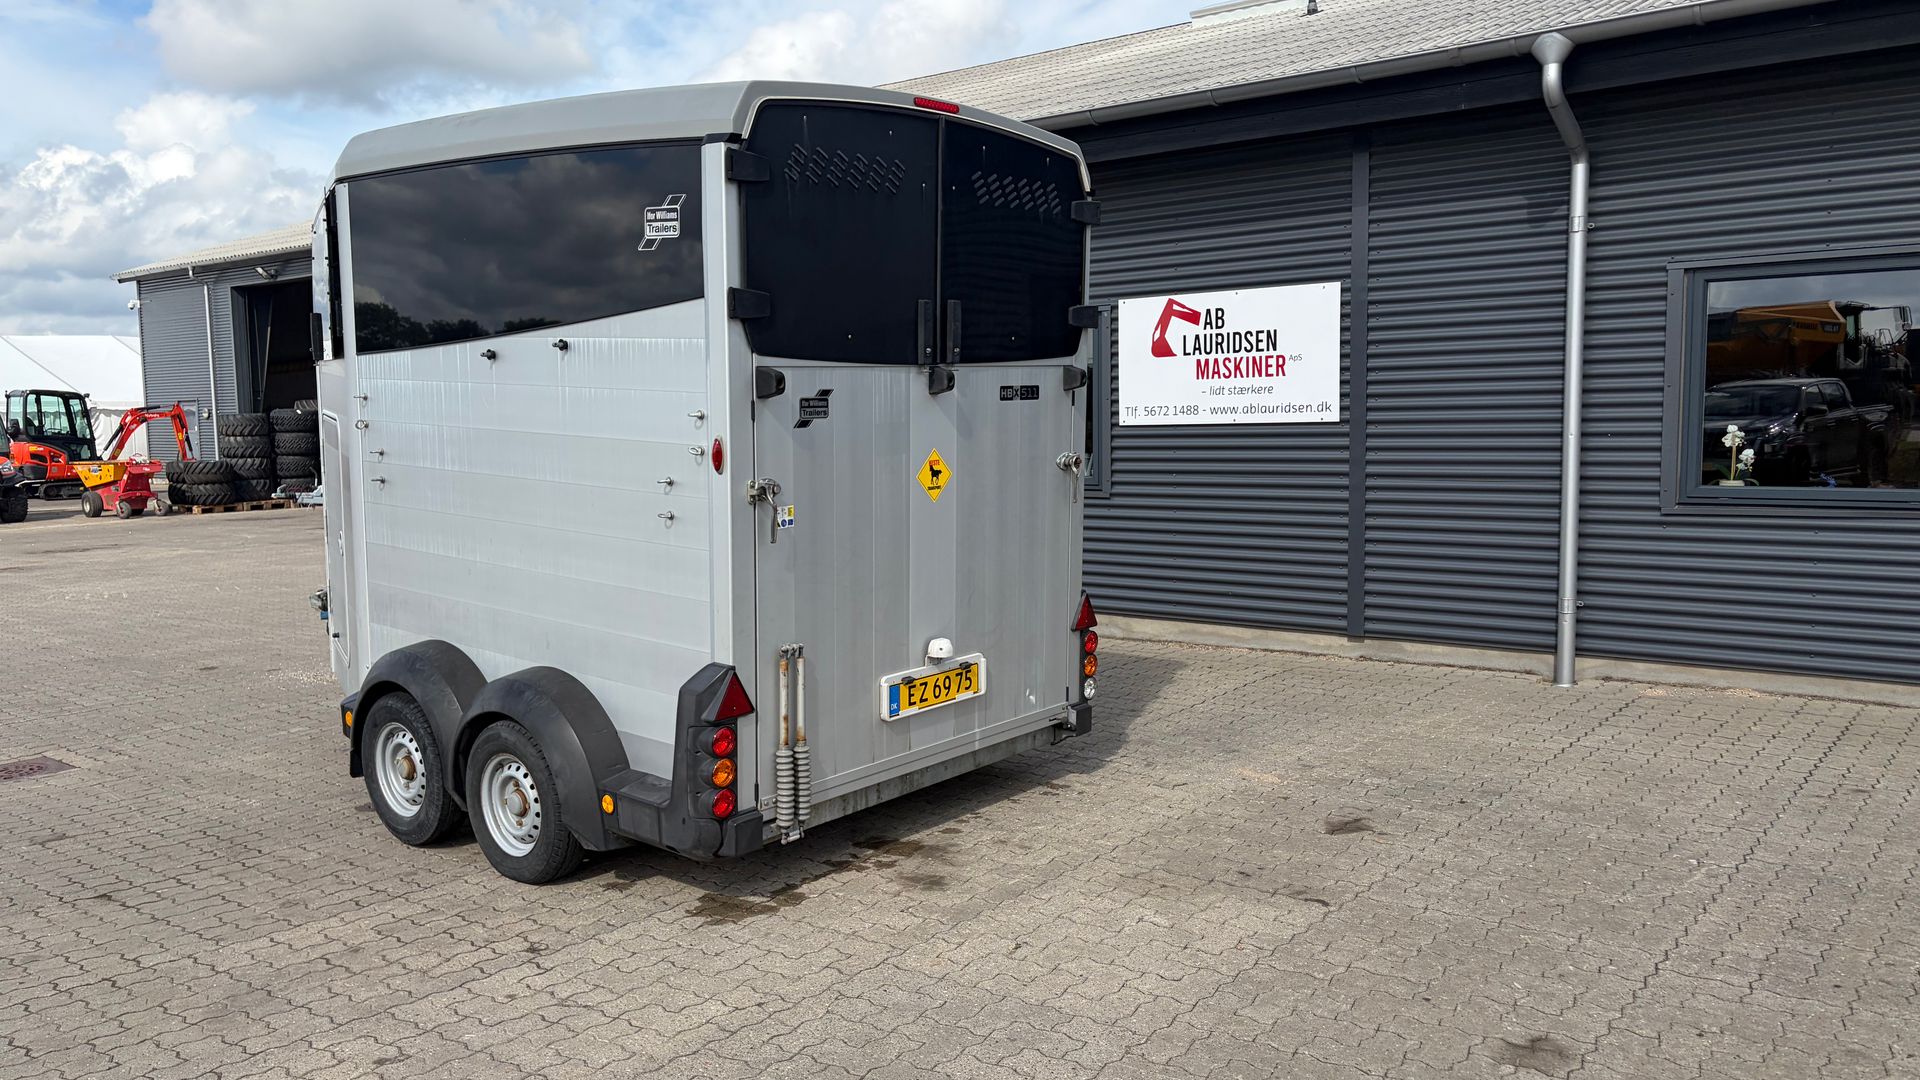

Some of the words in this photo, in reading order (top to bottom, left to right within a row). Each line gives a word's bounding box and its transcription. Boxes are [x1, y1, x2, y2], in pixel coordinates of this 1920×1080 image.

[648, 224, 677, 233] Trailers
[1203, 308, 1225, 330] AB
[1183, 329, 1278, 356] LAURIDSEN
[1196, 354, 1286, 380] MASKINER
[1288, 353, 1303, 362] ApS
[1209, 385, 1225, 396] lidt
[1227, 384, 1274, 396] stærkere
[802, 409, 827, 417] Trailers
[1125, 406, 1141, 419] Tlf.
[1144, 405, 1170, 417] 5672
[1172, 404, 1199, 416] 1488
[1209, 401, 1332, 416] www.ablauridsen.dk
[907, 681, 928, 706] EZ
[890, 703, 898, 711] DK
